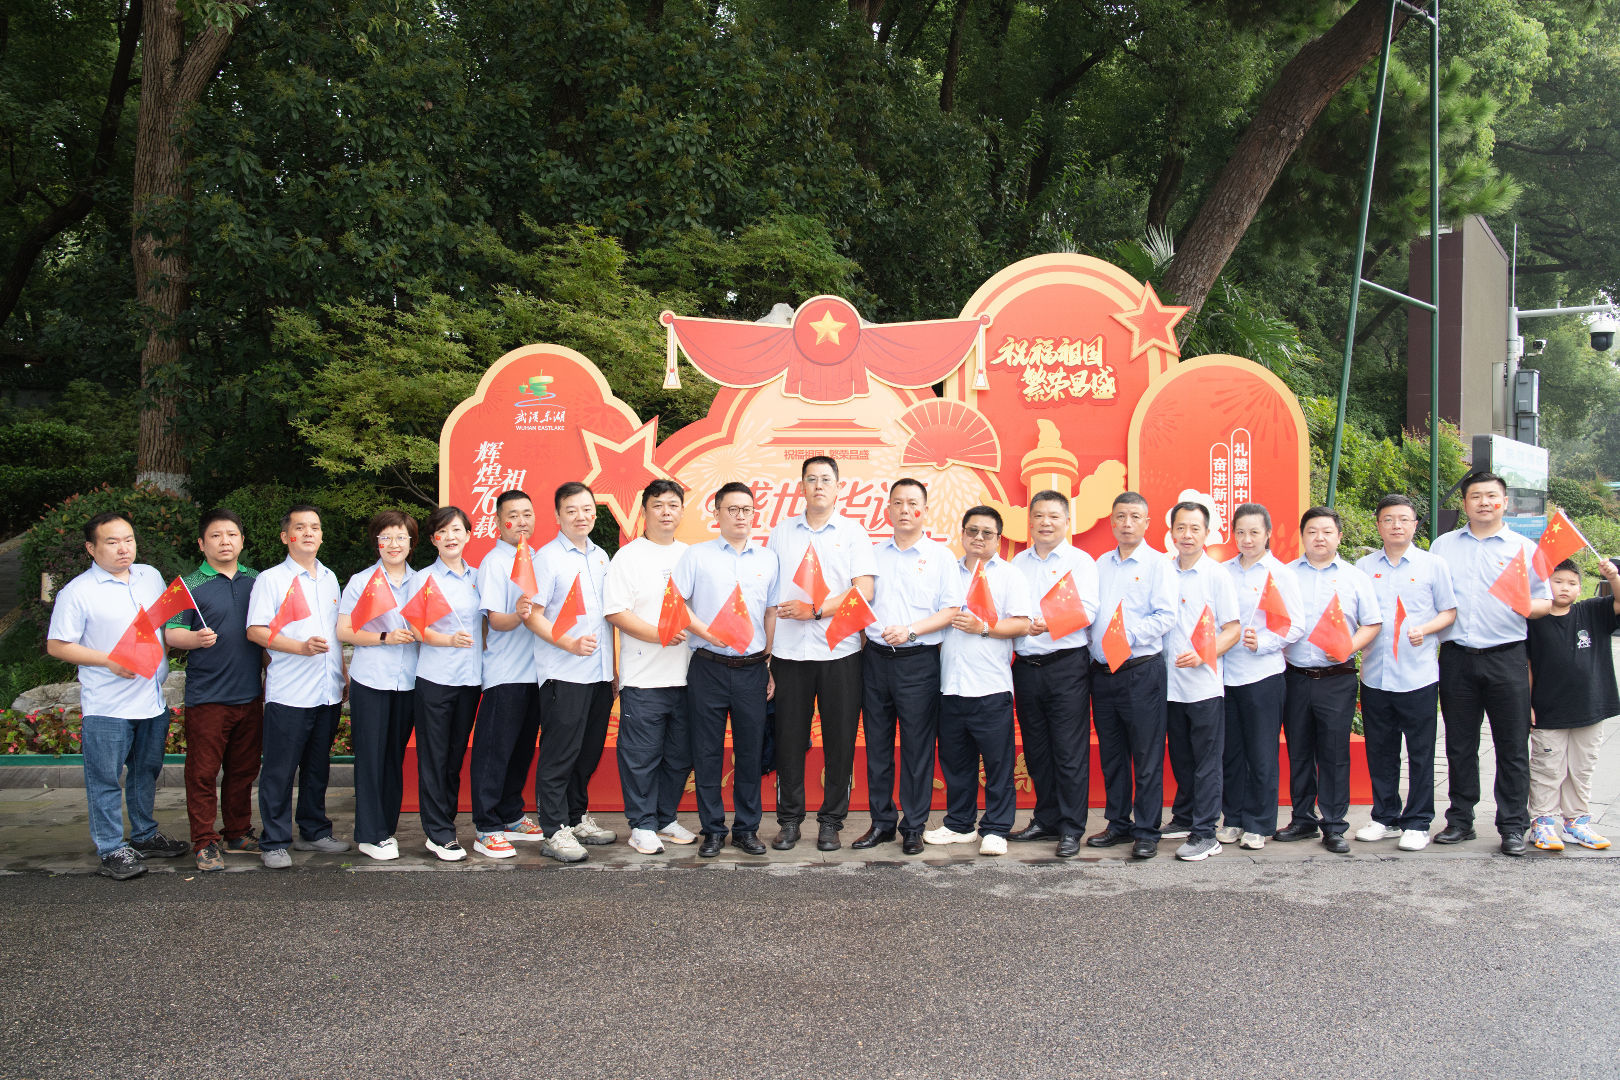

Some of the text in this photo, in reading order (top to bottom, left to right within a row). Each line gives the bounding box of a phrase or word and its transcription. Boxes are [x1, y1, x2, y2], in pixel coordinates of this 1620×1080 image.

[990, 336, 1103, 367] 祝福祖国
[1020, 364, 1117, 402] 繁荣昌盛
[1234, 443, 1248, 513] 礼赞新中
